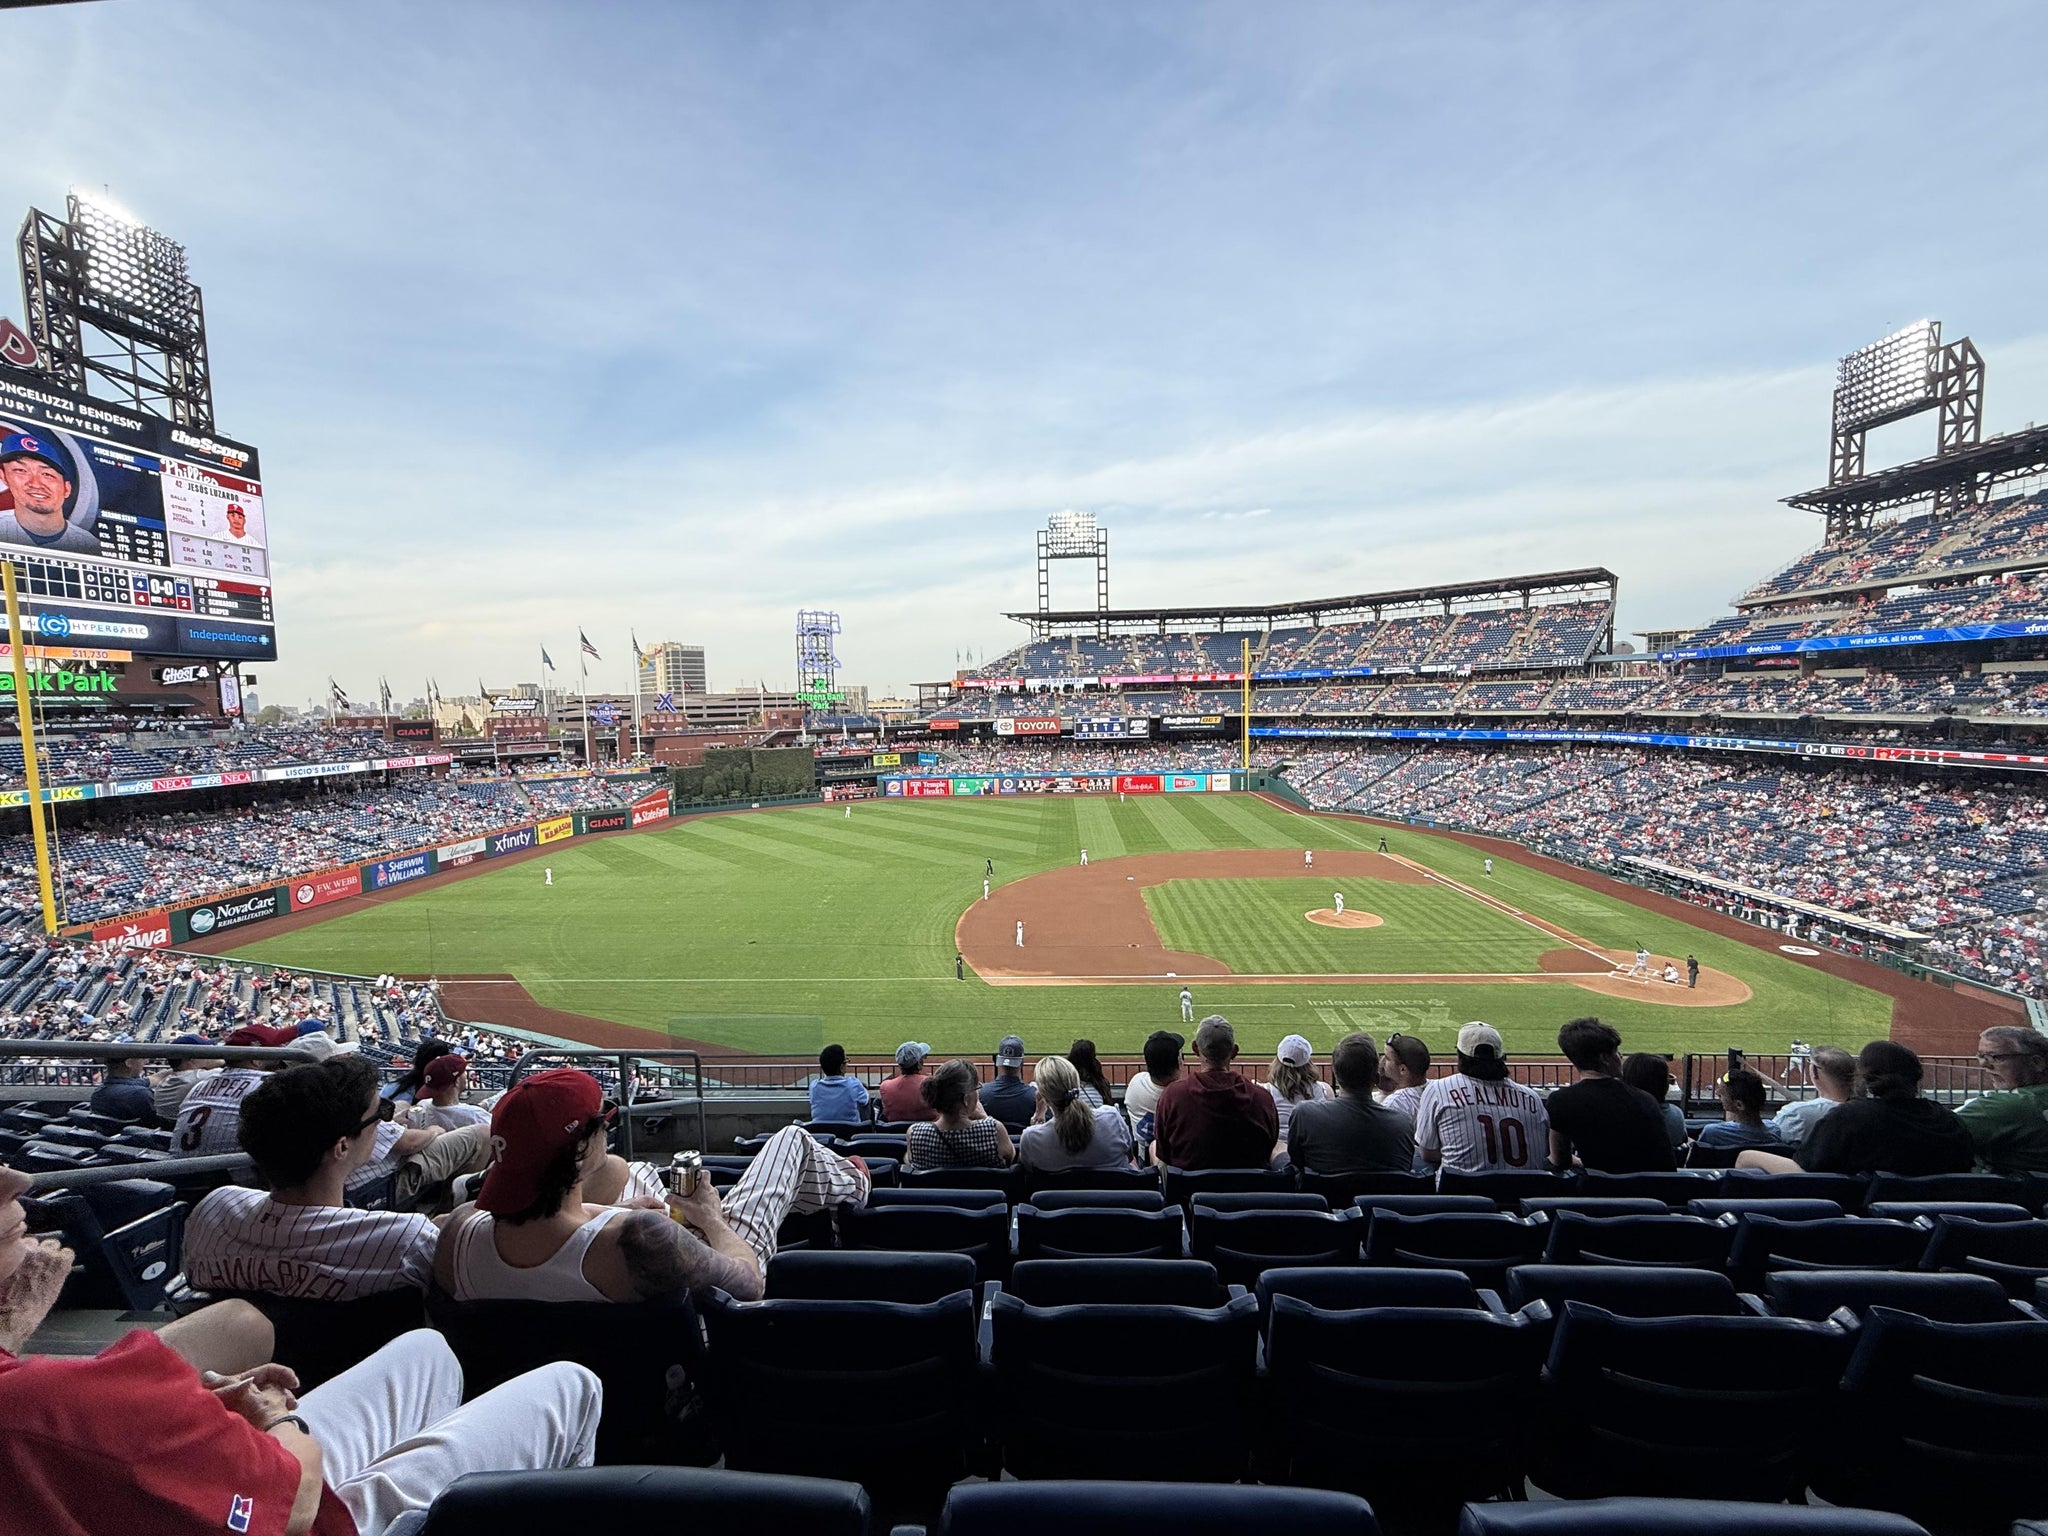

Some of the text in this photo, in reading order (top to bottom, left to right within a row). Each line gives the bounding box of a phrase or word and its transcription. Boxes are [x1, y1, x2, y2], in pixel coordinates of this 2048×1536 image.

[46, 409, 110, 435] LAWYERS
[79, 404, 142, 431] BENDESKY
[171, 429, 249, 462] theScore
[222, 456, 243, 468] BET
[160, 457, 219, 487] Phillies
[170, 494, 187, 502] BALLS
[209, 487, 239, 502] LUZARDO
[171, 504, 193, 513] STRIKES
[137, 547, 149, 555] SLG
[87, 573, 127, 586] 0 0 0
[194, 578, 219, 590] DUE UP
[150, 579, 174, 597] 0-0
[180, 586, 186, 594] 2
[88, 589, 128, 602] 0 0 0
[138, 595, 188, 608] 4 2
[72, 623, 147, 635] HYPERBARIC
[189, 629, 257, 642] Independence
[1850, 637, 1863, 645] WiFi
[1747, 645, 1763, 654] xfinity
[57, 671, 118, 691] Park
[162, 665, 199, 685] GHOST
[796, 692, 846, 700] Citizens Bank
[813, 702, 830, 710] Park
[1016, 722, 1057, 730] TOYOTA
[1163, 716, 1200, 725] theScore
[1805, 744, 1827, 755] 0-0
[388, 755, 450, 767] TOYOTA TOYOTA
[285, 765, 350, 777] LISCIO'S BAKERY
[157, 778, 188, 789] NECA
[223, 772, 250, 784] NECA
[923, 781, 945, 789] Temple
[51, 787, 83, 800] UKG
[590, 817, 625, 828] GIANT
[494, 831, 531, 852] xfinity
[388, 856, 424, 872] SHERWIN
[453, 855, 473, 866] LAGER
[315, 865, 350, 877] ASPLUNDH
[270, 874, 308, 888] ASPLUNDH
[333, 876, 358, 888] WEBB
[218, 884, 262, 900] ASPLUNDH
[326, 887, 349, 896] COMPANY
[159, 897, 209, 914] ASPLUNDH
[216, 897, 276, 920] NovaCare
[92, 911, 149, 929] ASPLUNDH
[217, 907, 274, 928] REHABILITATION
[1314, 1007, 1464, 1032] IBX
[192, 1078, 251, 1098] HARPER
[1450, 1086, 1537, 1114] REALMUTO
[181, 1106, 212, 1151] 3
[1477, 1114, 1528, 1168] 10
[490, 1134, 507, 1163] P
